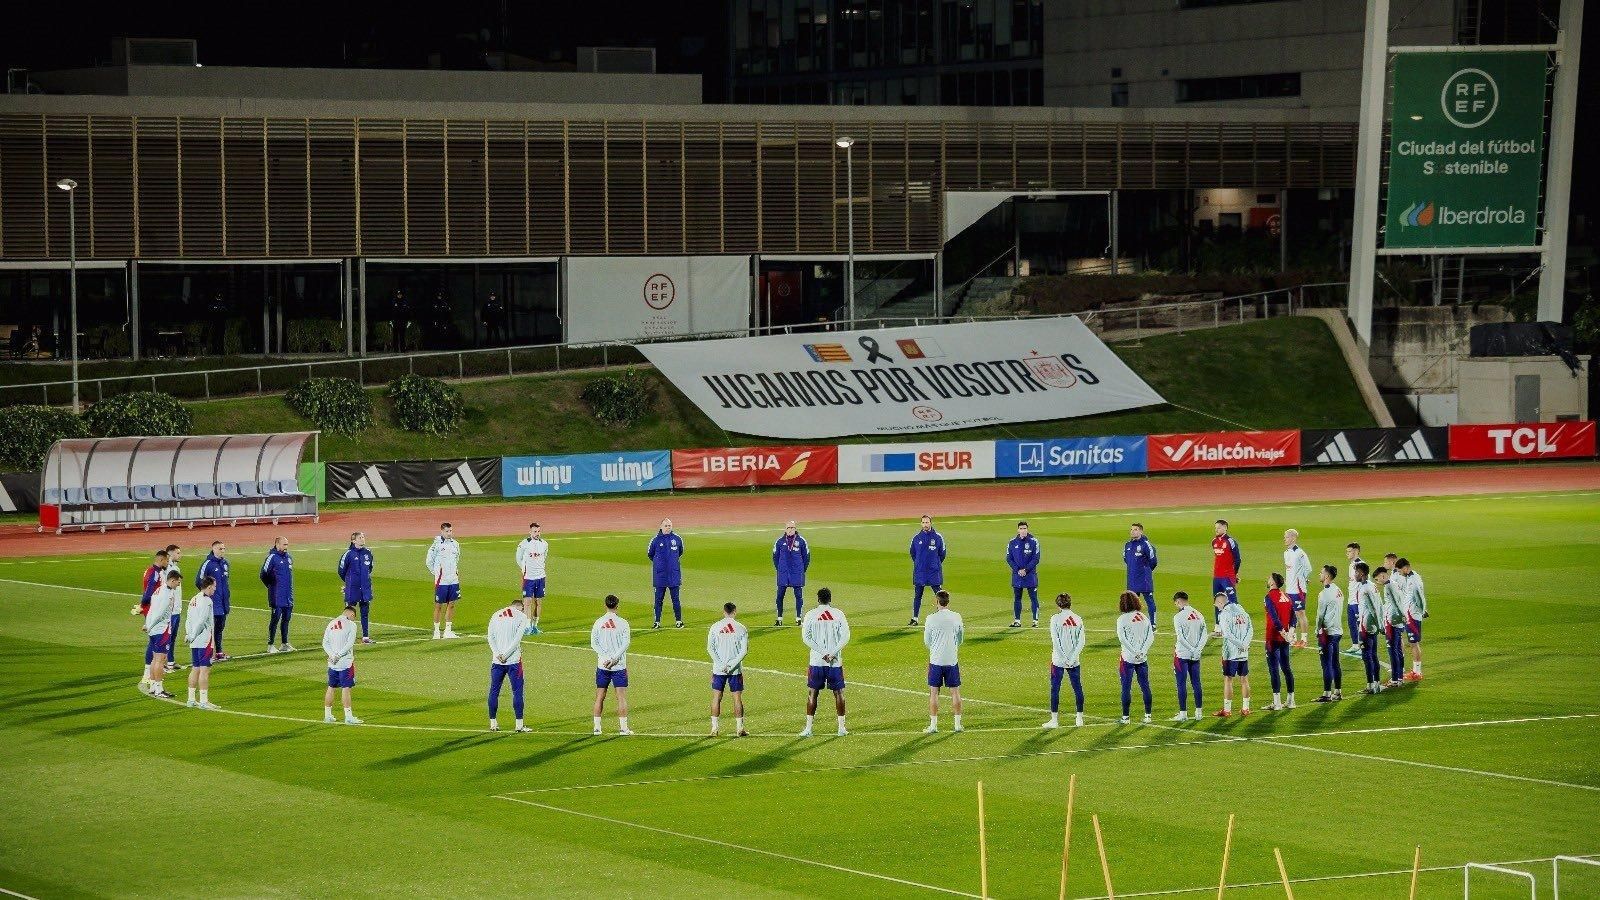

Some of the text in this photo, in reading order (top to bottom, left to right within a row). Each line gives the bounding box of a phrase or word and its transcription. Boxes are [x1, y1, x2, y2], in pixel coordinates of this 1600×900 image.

[1397, 139, 1536, 156] Ciudad del fútbol
[1423, 160, 1509, 175] Sstenible
[1438, 206, 1525, 225] Iberdrola
[702, 353, 1100, 409] JUGAMOS POR VOSOTRS
[1193, 442, 1285, 461] Halcón viajes
[1487, 428, 1557, 455] TCL
[702, 454, 781, 472] IBERIA
[918, 451, 972, 471] SEUR
[1049, 444, 1124, 466] Sanitas
[517, 460, 572, 490] wimu
[601, 456, 654, 487] wimu
